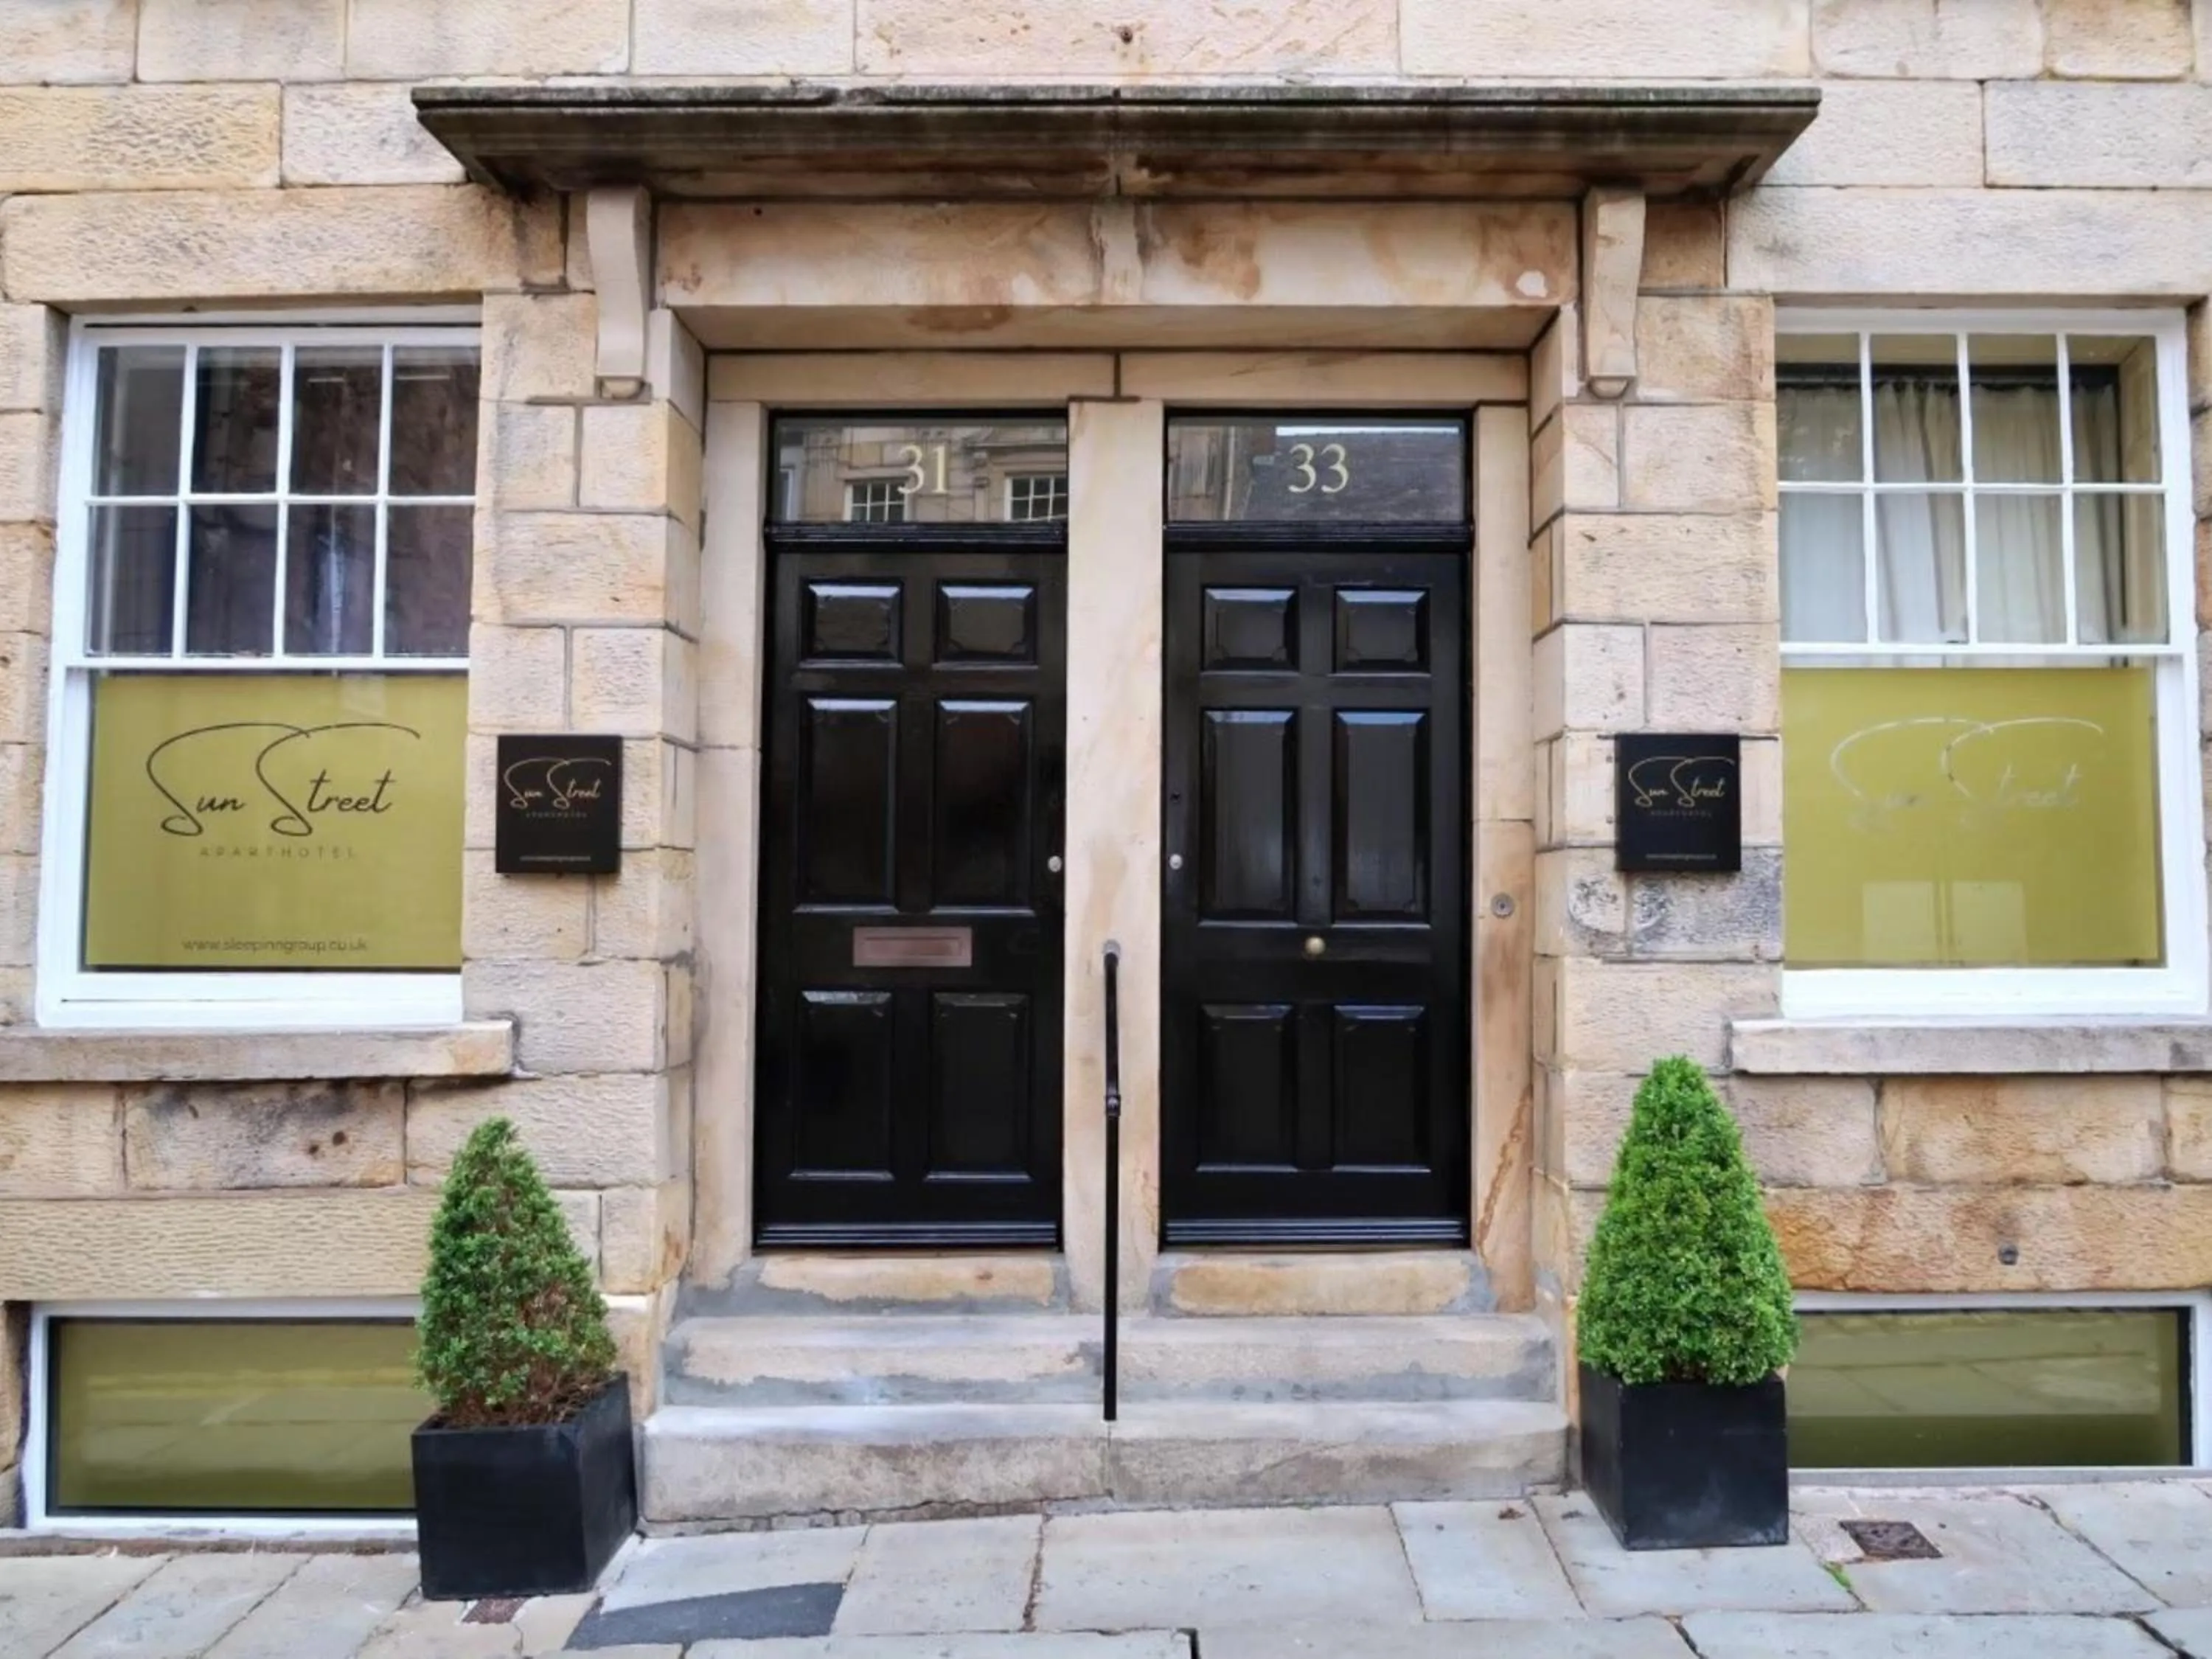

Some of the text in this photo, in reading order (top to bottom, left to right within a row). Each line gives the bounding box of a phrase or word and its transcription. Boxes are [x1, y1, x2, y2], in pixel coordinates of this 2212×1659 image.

[897, 445, 948, 493] 31
[1288, 443, 1349, 493] 33
[145, 722, 421, 837] Sun Street
[503, 756, 612, 810] Sun Street
[1627, 755, 1735, 807] Sun Street
[199, 845, 355, 860] APARTHOTEL
